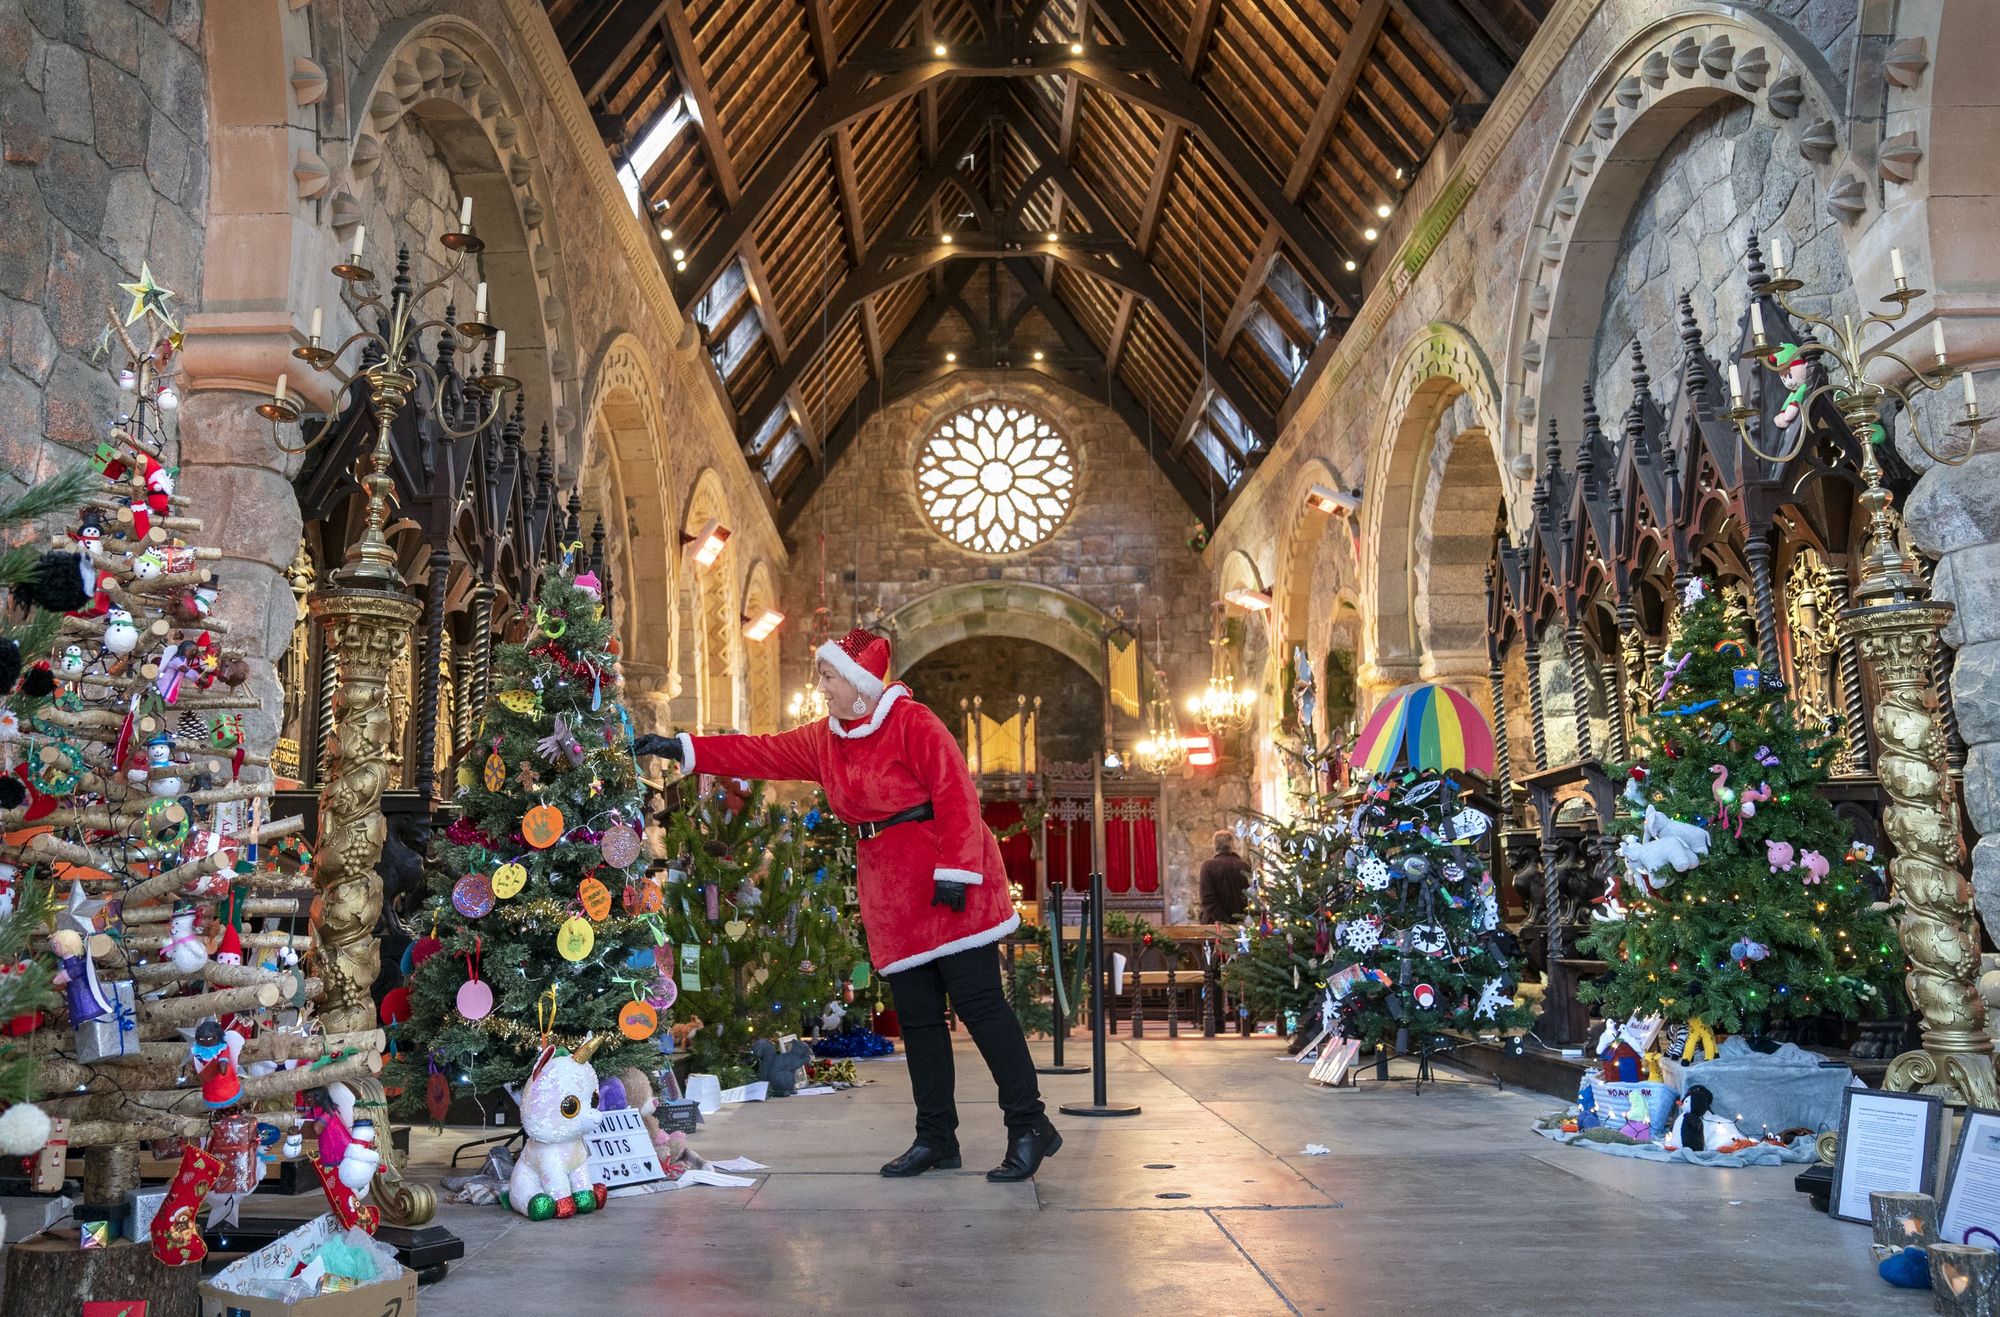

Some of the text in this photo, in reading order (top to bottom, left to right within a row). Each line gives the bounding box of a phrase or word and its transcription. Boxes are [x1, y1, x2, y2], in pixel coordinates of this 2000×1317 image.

[1641, 1089, 1652, 1097] RK
[593, 1114, 641, 1133] NUILT
[591, 1139, 631, 1157] TOTS
